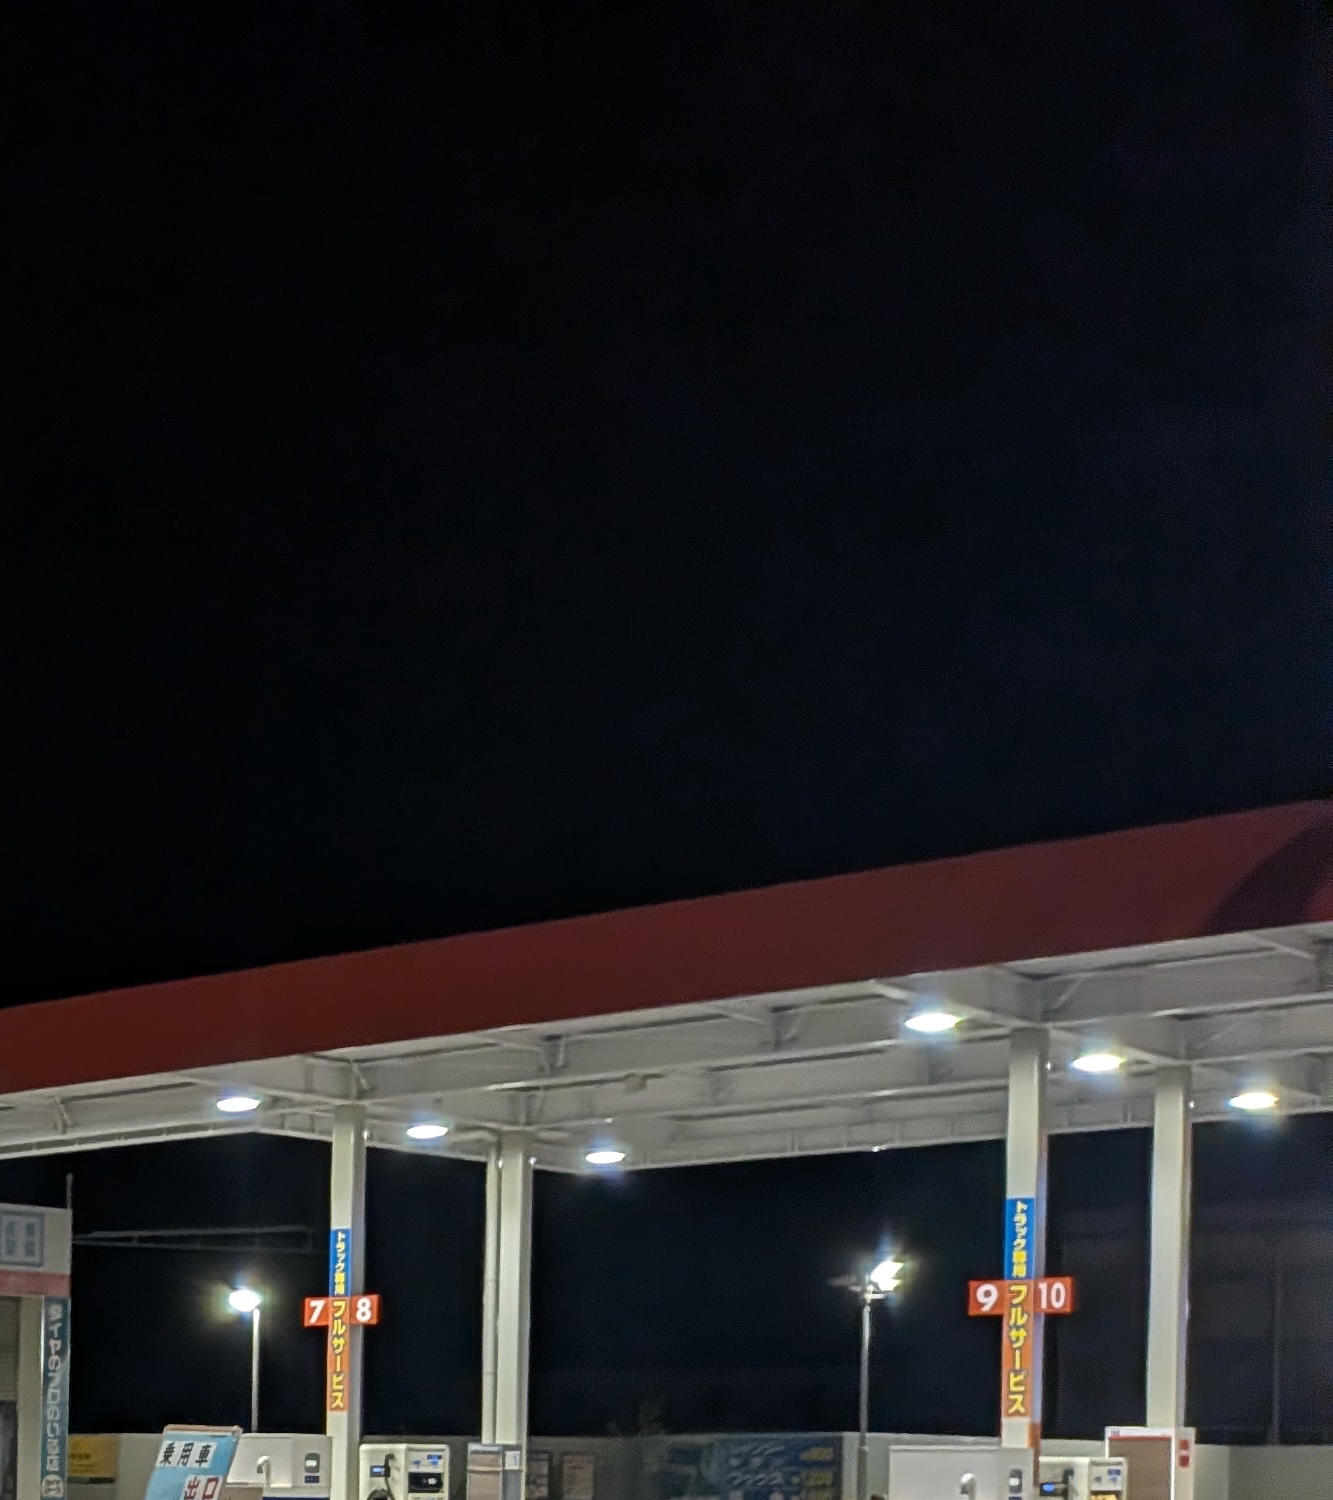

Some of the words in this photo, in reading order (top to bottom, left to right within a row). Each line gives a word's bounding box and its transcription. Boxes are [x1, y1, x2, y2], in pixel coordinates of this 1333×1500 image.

[976, 1283, 998, 1312] 9
[1038, 1282, 1066, 1310] 10
[309, 1300, 325, 1324] 7
[355, 1298, 372, 1322] 8
[331, 1301, 346, 1409] フルサービス
[1008, 1285, 1028, 1414] フルサービス
[160, 1442, 212, 1466] 乗用車
[184, 1476, 220, 1500] 出口
